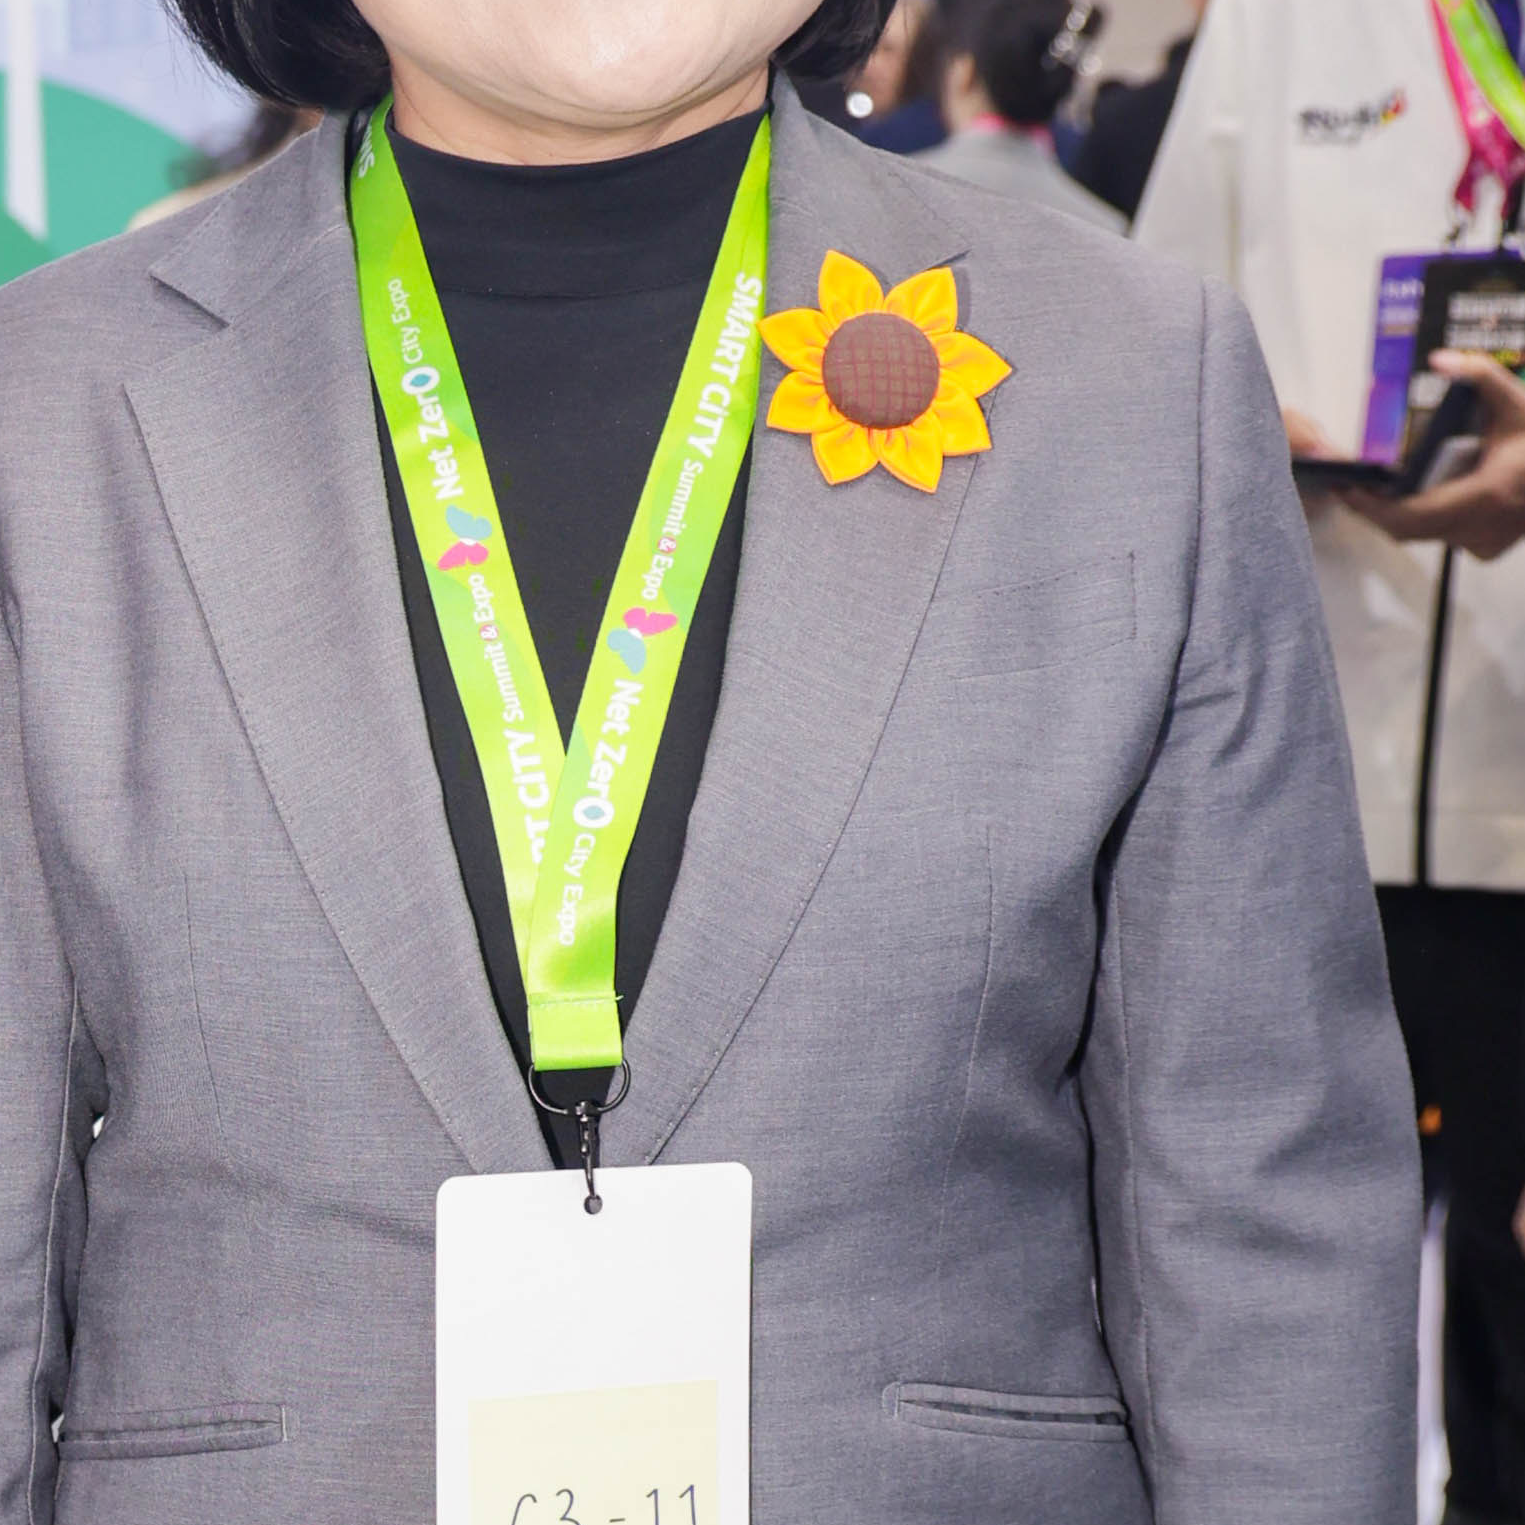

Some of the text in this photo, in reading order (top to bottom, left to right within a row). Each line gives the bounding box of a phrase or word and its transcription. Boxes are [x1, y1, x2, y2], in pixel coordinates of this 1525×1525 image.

[388, 277, 412, 324] Expo
[714, 272, 762, 383] SMART
[401, 325, 423, 365] City
[428, 444, 464, 501] Net
[662, 457, 704, 536] Summit
[468, 573, 494, 625] Expo
[641, 554, 674, 601] Expo
[483, 641, 524, 723] Summit
[602, 678, 643, 735] Net
[564, 832, 595, 877] City
[556, 884, 583, 946] Expo
